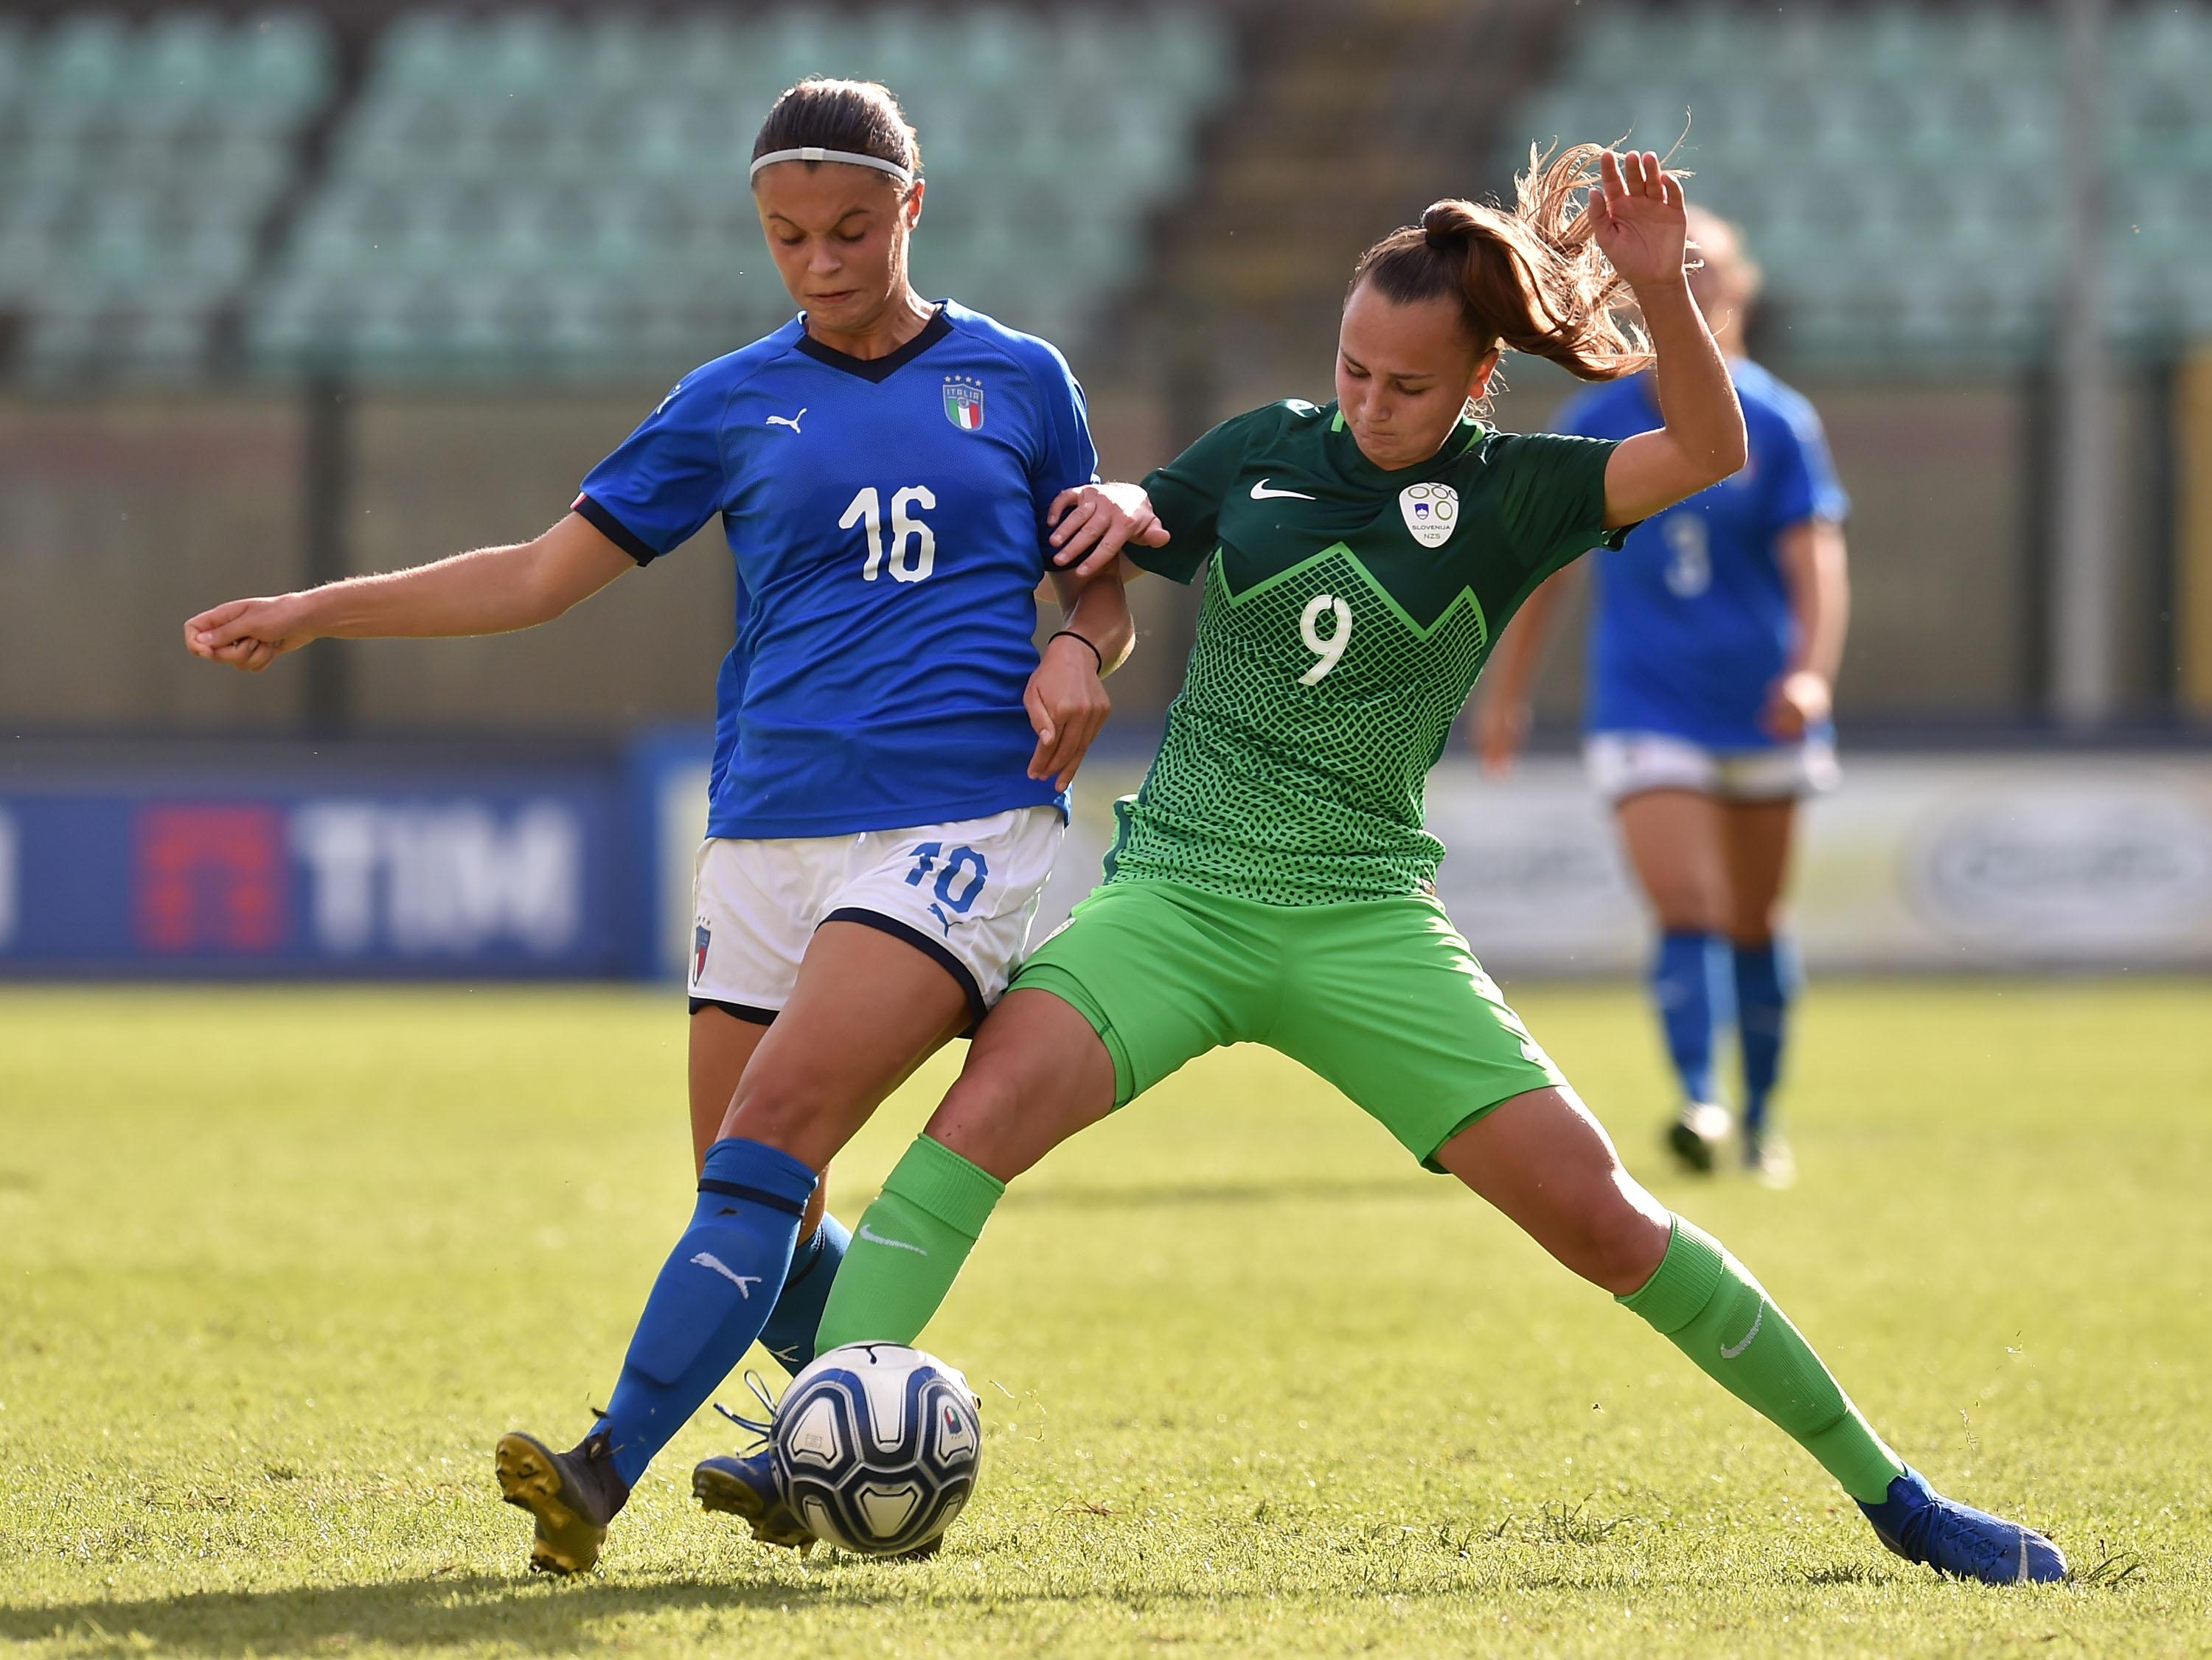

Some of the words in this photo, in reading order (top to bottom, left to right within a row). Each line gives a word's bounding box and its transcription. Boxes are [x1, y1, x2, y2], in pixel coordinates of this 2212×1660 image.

[947, 388, 979, 400] ITALIA
[838, 485, 936, 583] 16
[1298, 594, 1352, 686] 9
[296, 802, 578, 952] TIM
[905, 842, 989, 914] 10
